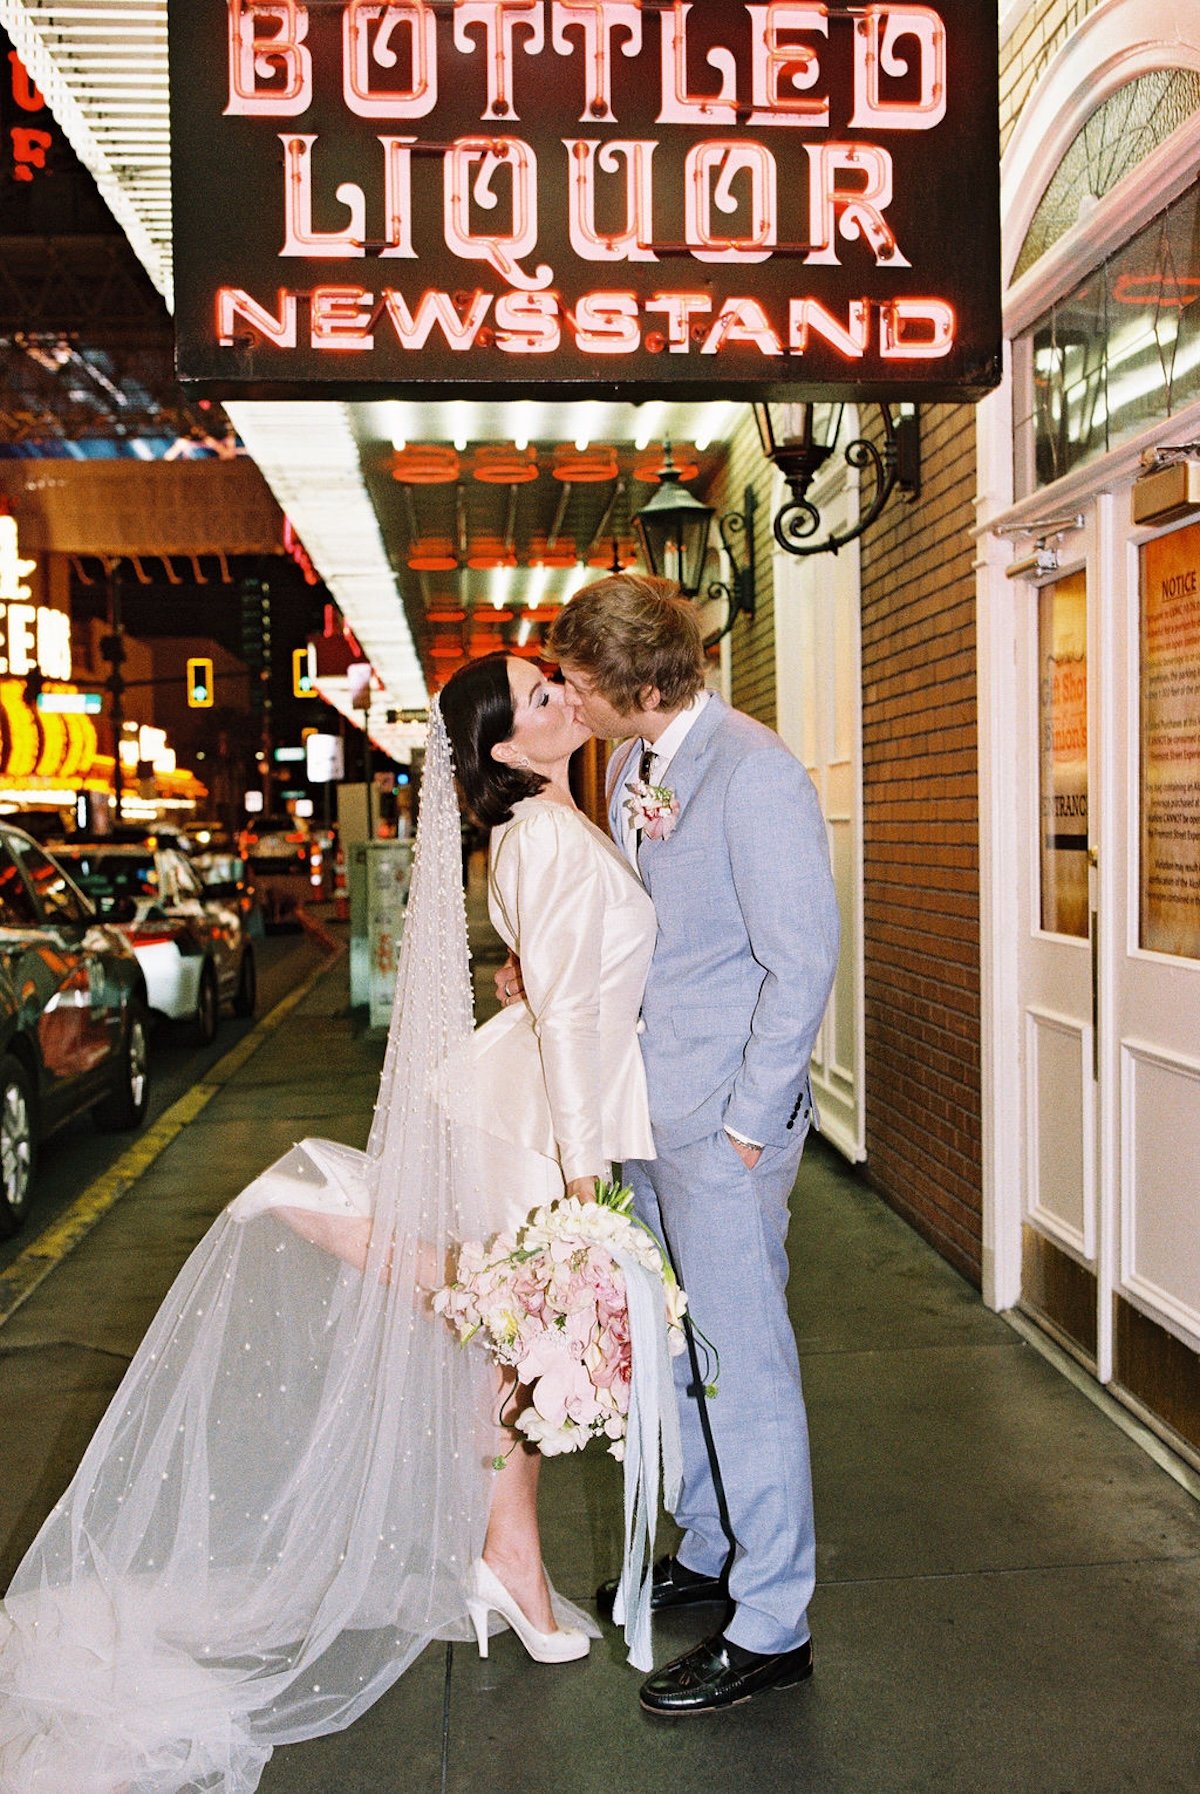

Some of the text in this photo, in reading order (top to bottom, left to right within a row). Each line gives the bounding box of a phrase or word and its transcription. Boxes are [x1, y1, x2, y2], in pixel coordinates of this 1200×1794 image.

[222, 0, 947, 129] BOTTLED
[277, 132, 912, 291] LIQUOR
[217, 287, 955, 359] NEWSSTAND
[1162, 570, 1196, 598] NOTICE
[1041, 794, 1088, 817] ENTRANC
